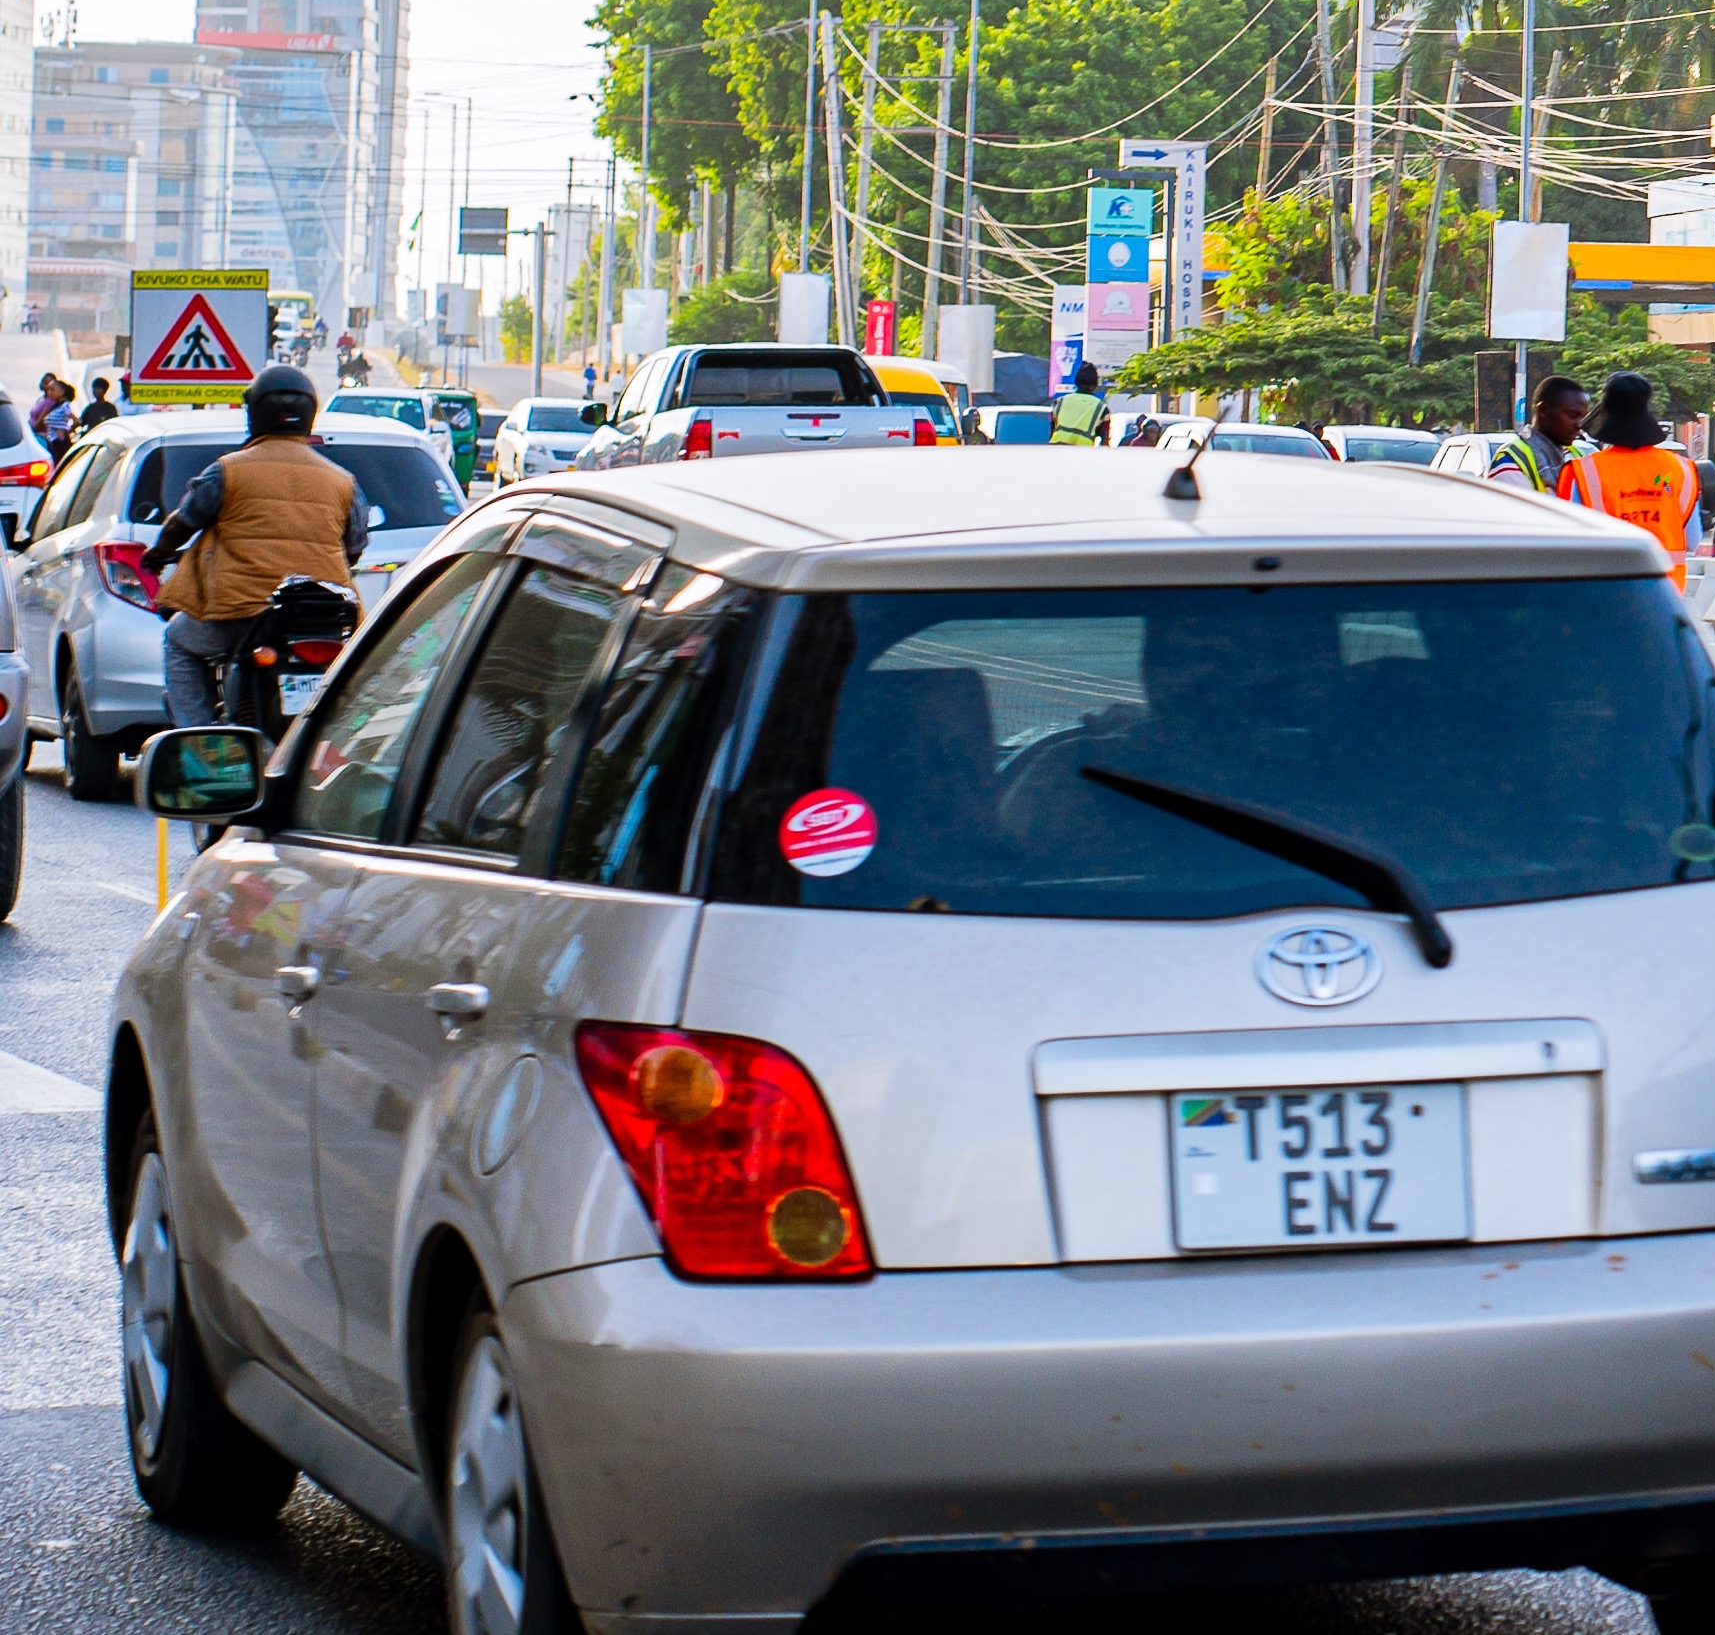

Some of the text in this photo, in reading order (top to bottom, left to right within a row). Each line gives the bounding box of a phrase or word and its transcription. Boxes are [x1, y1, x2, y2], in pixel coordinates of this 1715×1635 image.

[1181, 148, 1197, 326] KAIRUKI HOSPI
[137, 274, 263, 285] KIVUKO CHA WATU
[132, 386, 202, 399] PEDESTRIAN
[1234, 1091, 1393, 1161] T513
[1284, 1168, 1397, 1236] ENZ
